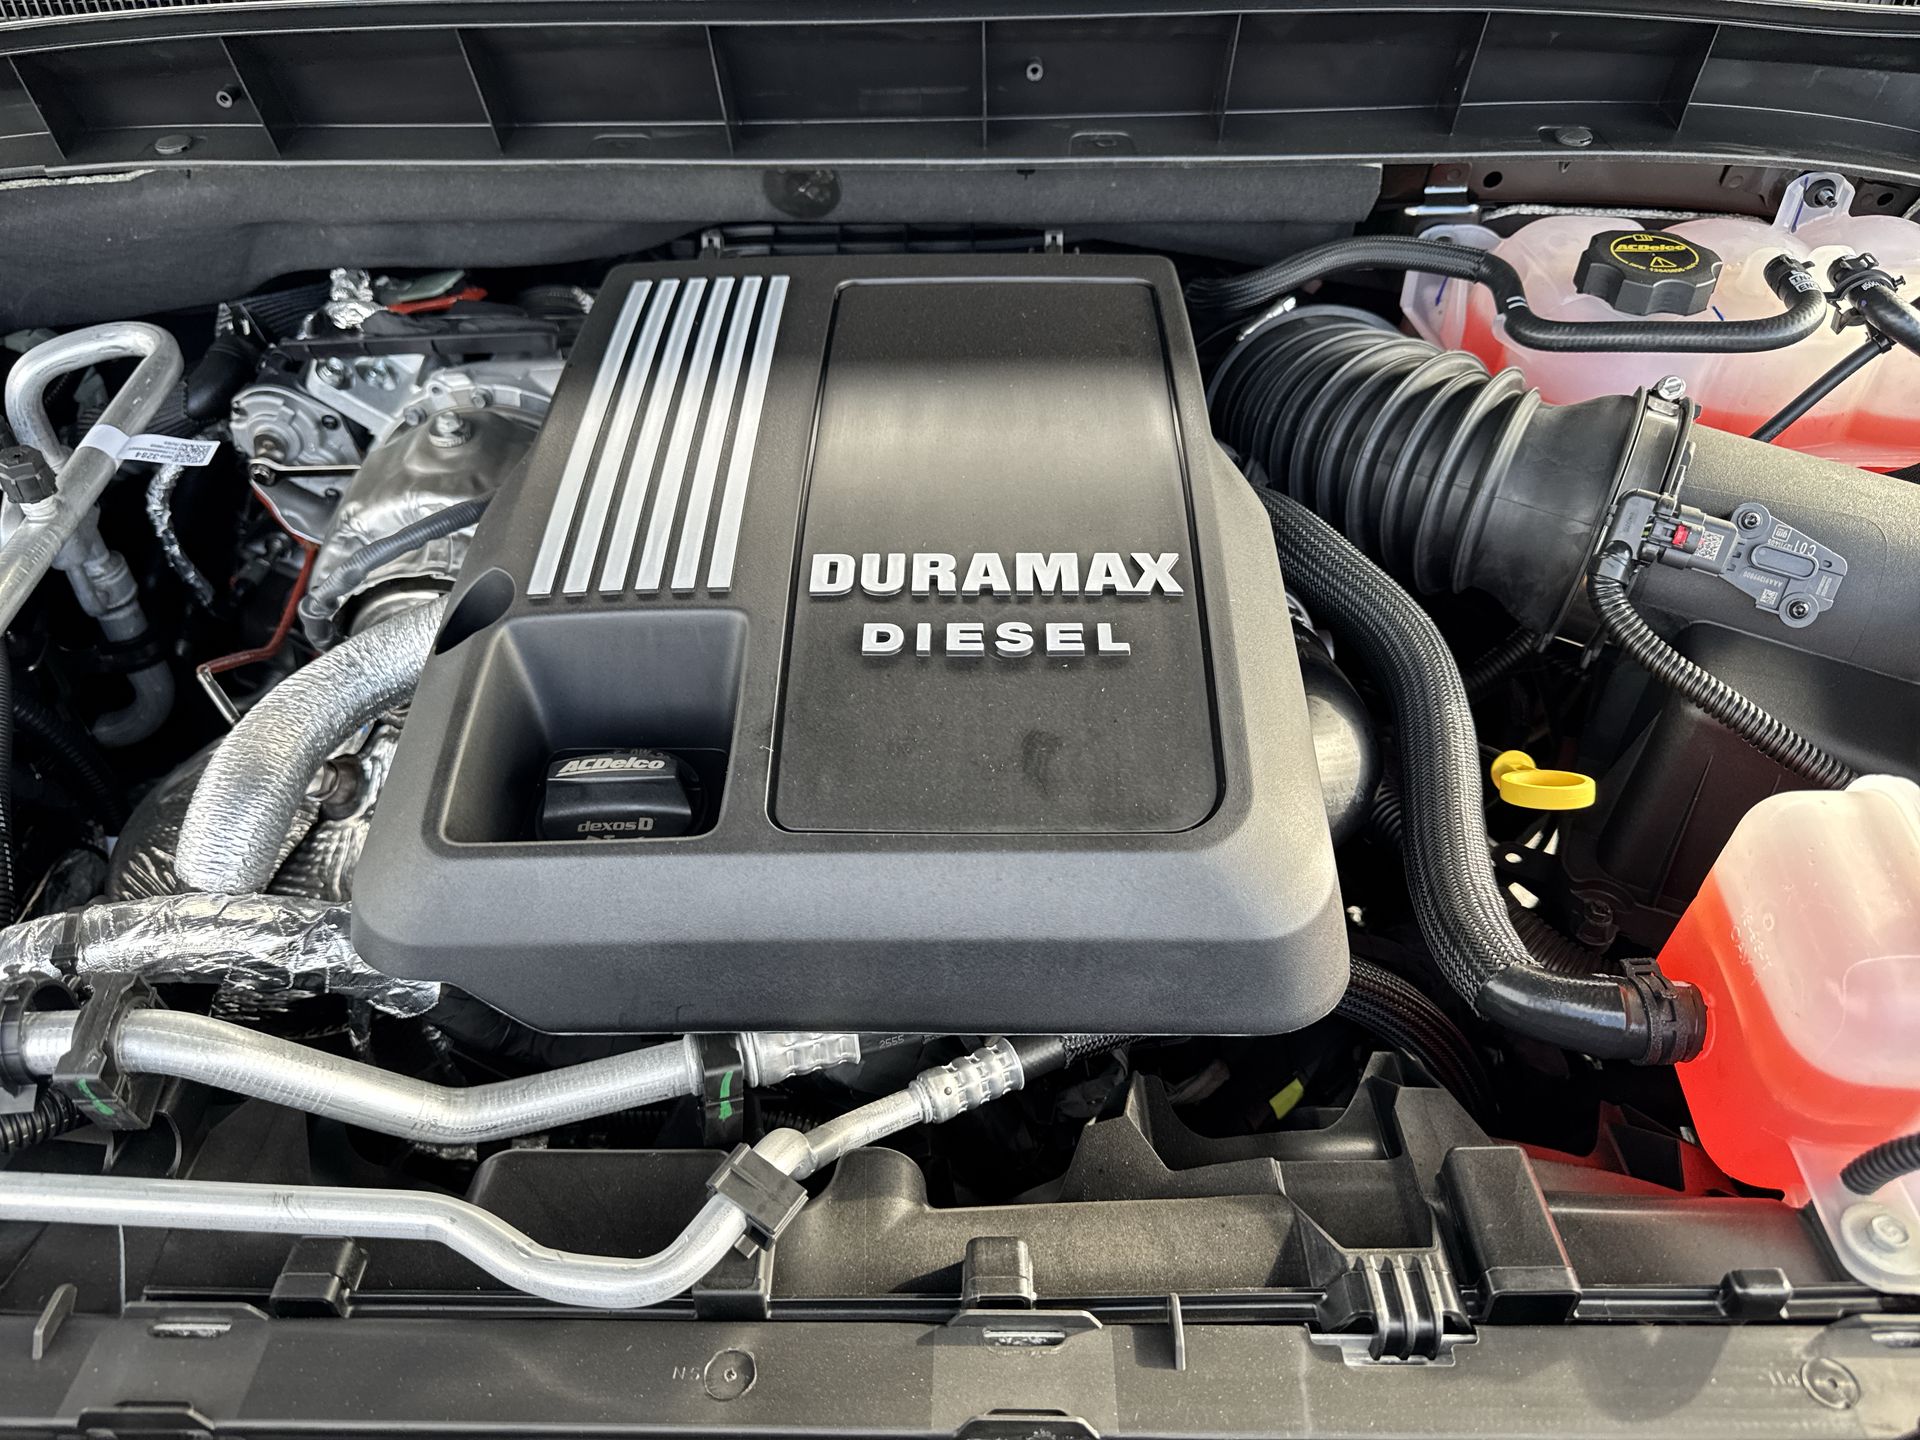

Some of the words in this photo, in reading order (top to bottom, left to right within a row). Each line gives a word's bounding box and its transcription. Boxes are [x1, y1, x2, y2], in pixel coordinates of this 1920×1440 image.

[1614, 243, 1686, 253] ACDelco
[808, 552, 1184, 597] DURAMAX
[861, 622, 1131, 656] DIESEL
[556, 757, 666, 776] ACDelco
[879, 1034, 905, 1049] 2555
